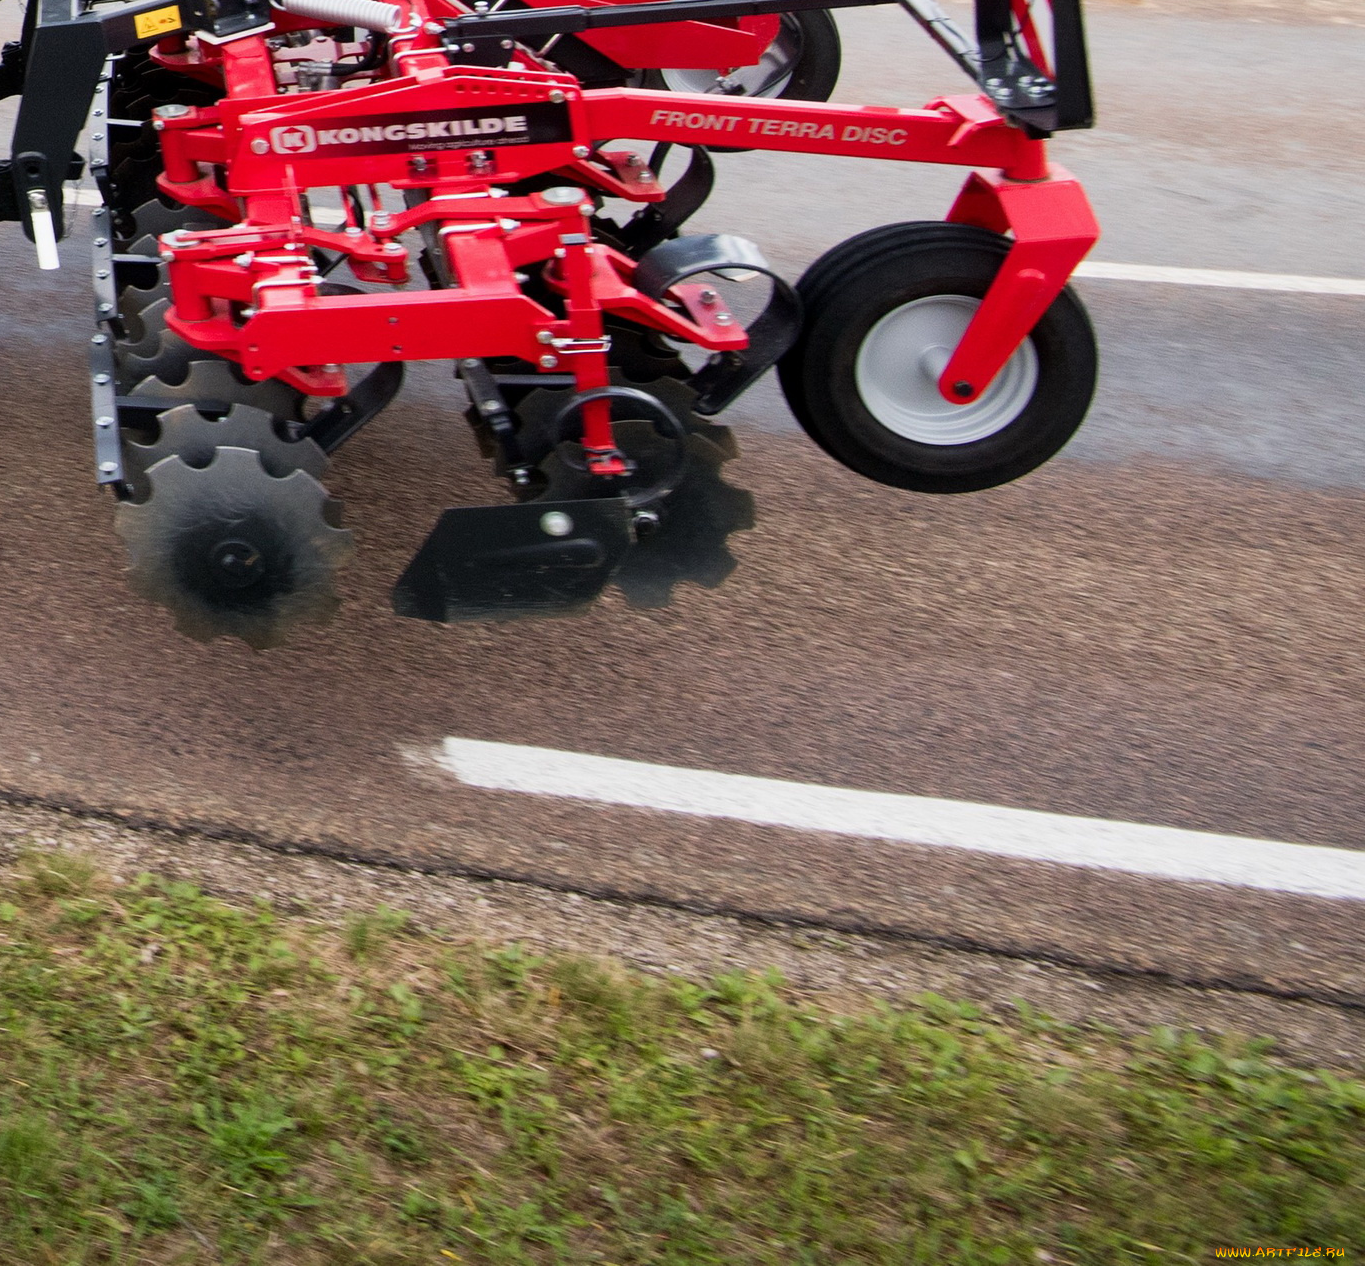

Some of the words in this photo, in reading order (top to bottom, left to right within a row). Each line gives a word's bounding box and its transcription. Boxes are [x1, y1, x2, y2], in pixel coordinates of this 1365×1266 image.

[317, 115, 528, 145] KONGSKILDE
[649, 109, 742, 132] FRONT
[747, 116, 835, 140] TERRA
[840, 125, 909, 145] DISC
